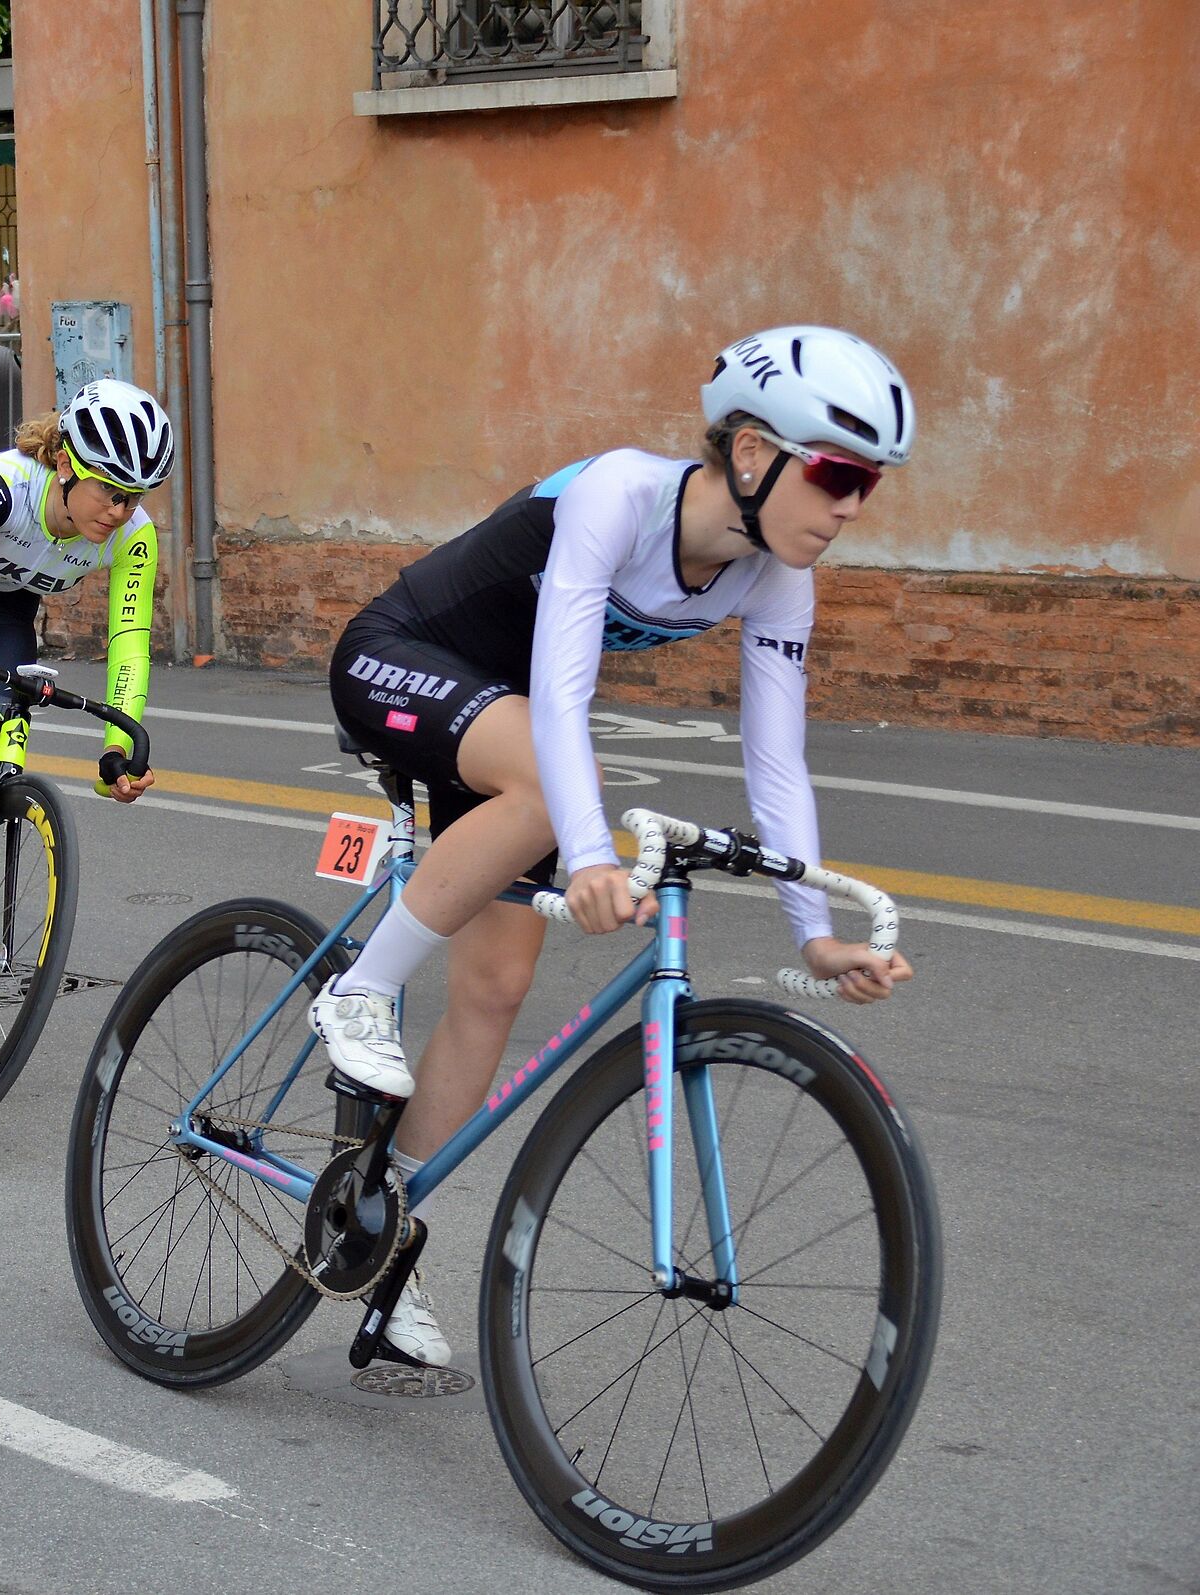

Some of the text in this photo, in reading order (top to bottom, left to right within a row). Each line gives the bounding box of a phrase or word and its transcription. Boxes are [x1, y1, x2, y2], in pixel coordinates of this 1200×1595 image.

[347, 654, 459, 701] DRALI
[367, 689, 410, 708] MILANO
[448, 684, 511, 736] DRALI
[333, 834, 364, 875] 23
